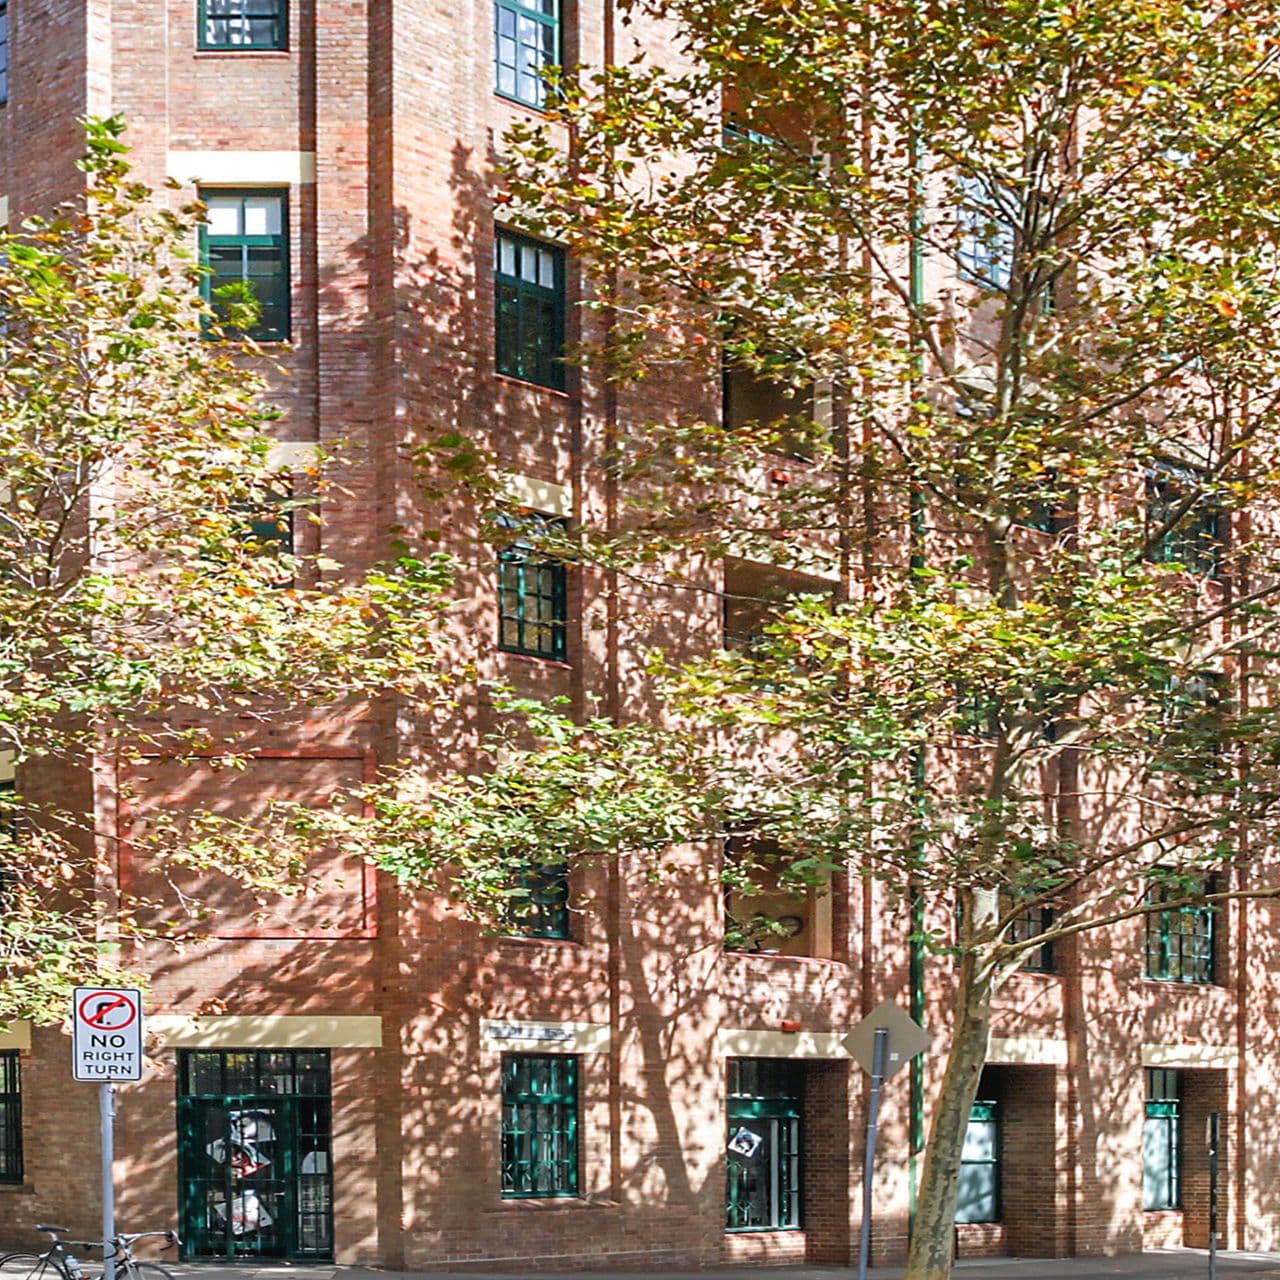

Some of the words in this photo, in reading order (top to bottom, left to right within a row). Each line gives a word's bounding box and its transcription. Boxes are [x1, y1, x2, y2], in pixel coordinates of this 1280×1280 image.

[91, 1034, 126, 1049] NO
[82, 1051, 135, 1062] RIGHT
[84, 1064, 132, 1075] TURN
